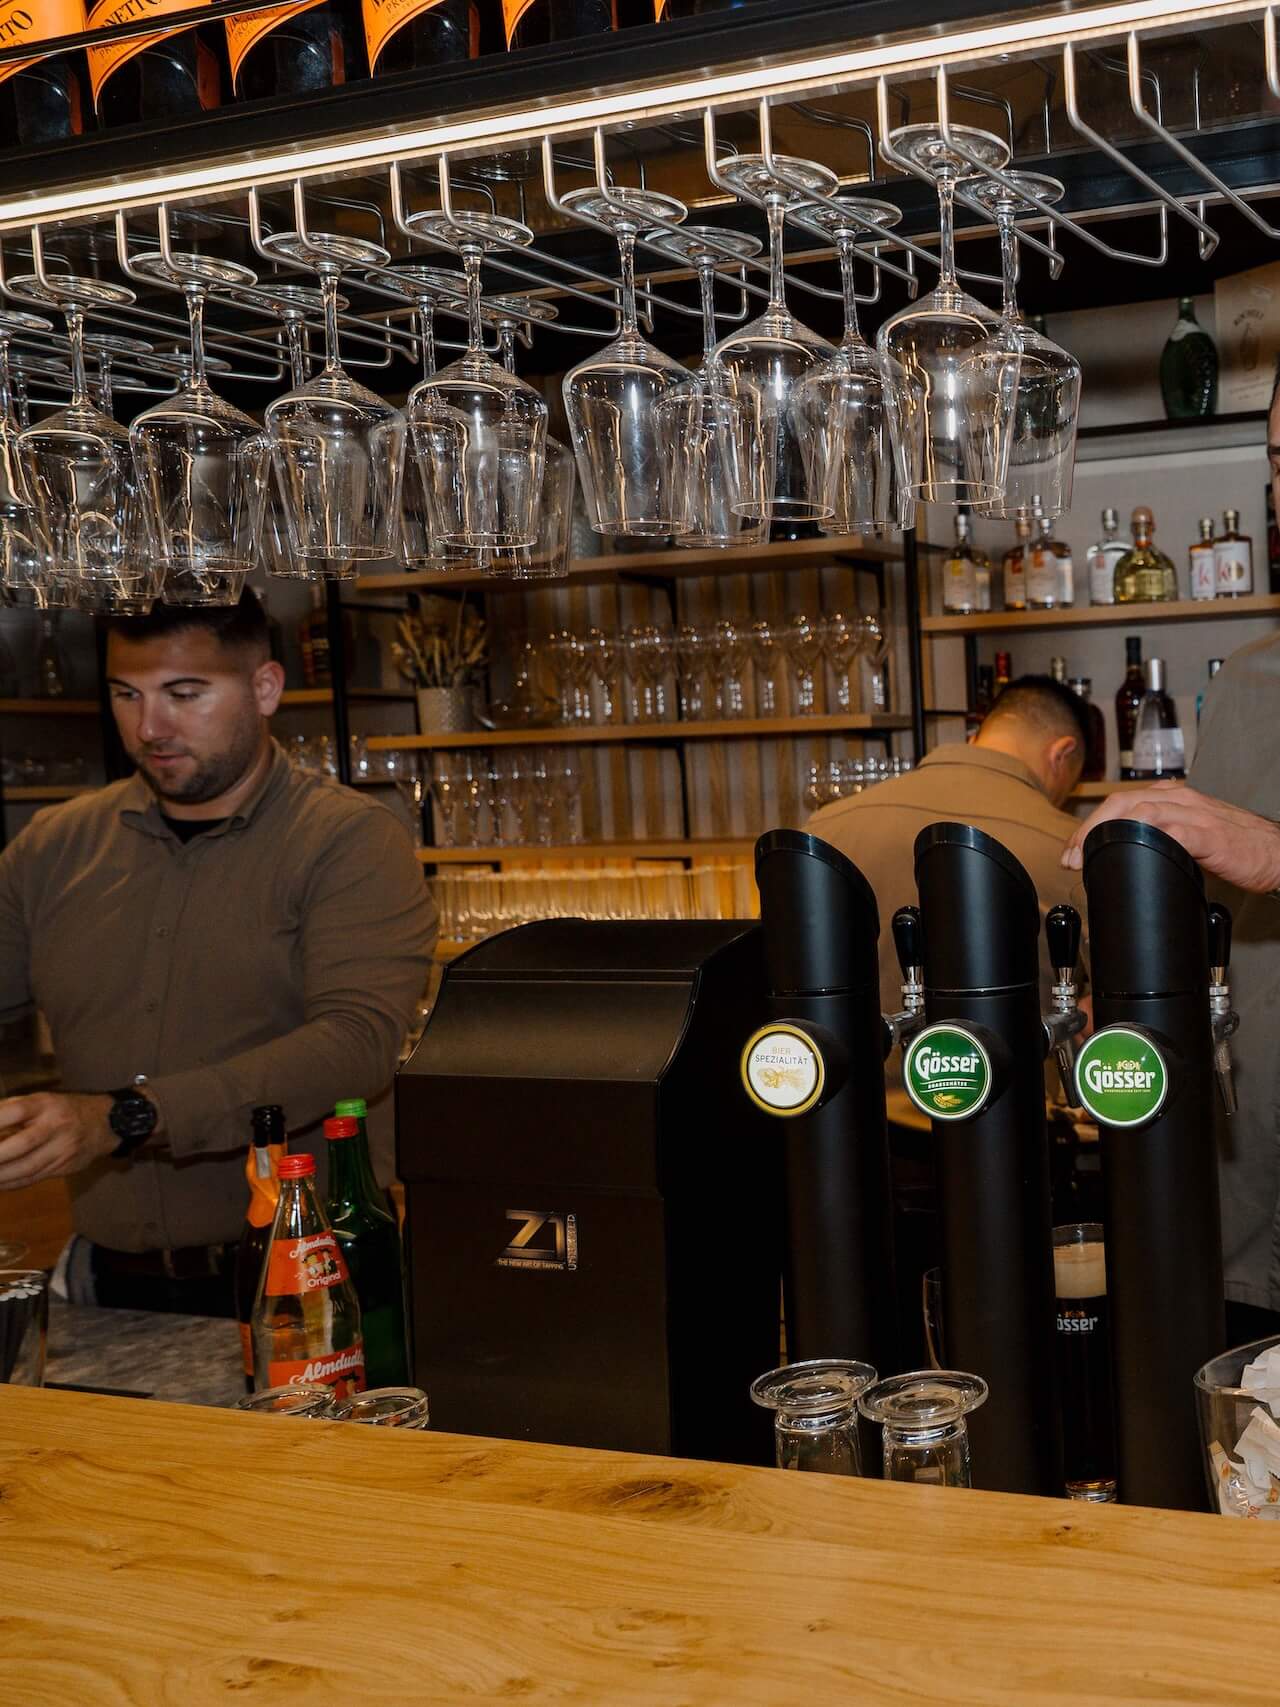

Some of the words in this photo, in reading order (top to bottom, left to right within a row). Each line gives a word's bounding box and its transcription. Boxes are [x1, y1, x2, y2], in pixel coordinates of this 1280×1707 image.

[755, 1054, 808, 1065] SPEZIALITÄT
[772, 1047, 791, 1055] BIER
[915, 1046, 980, 1081] Gösser
[1085, 1059, 1156, 1094] Gösser
[1056, 1313, 1099, 1331] össer
